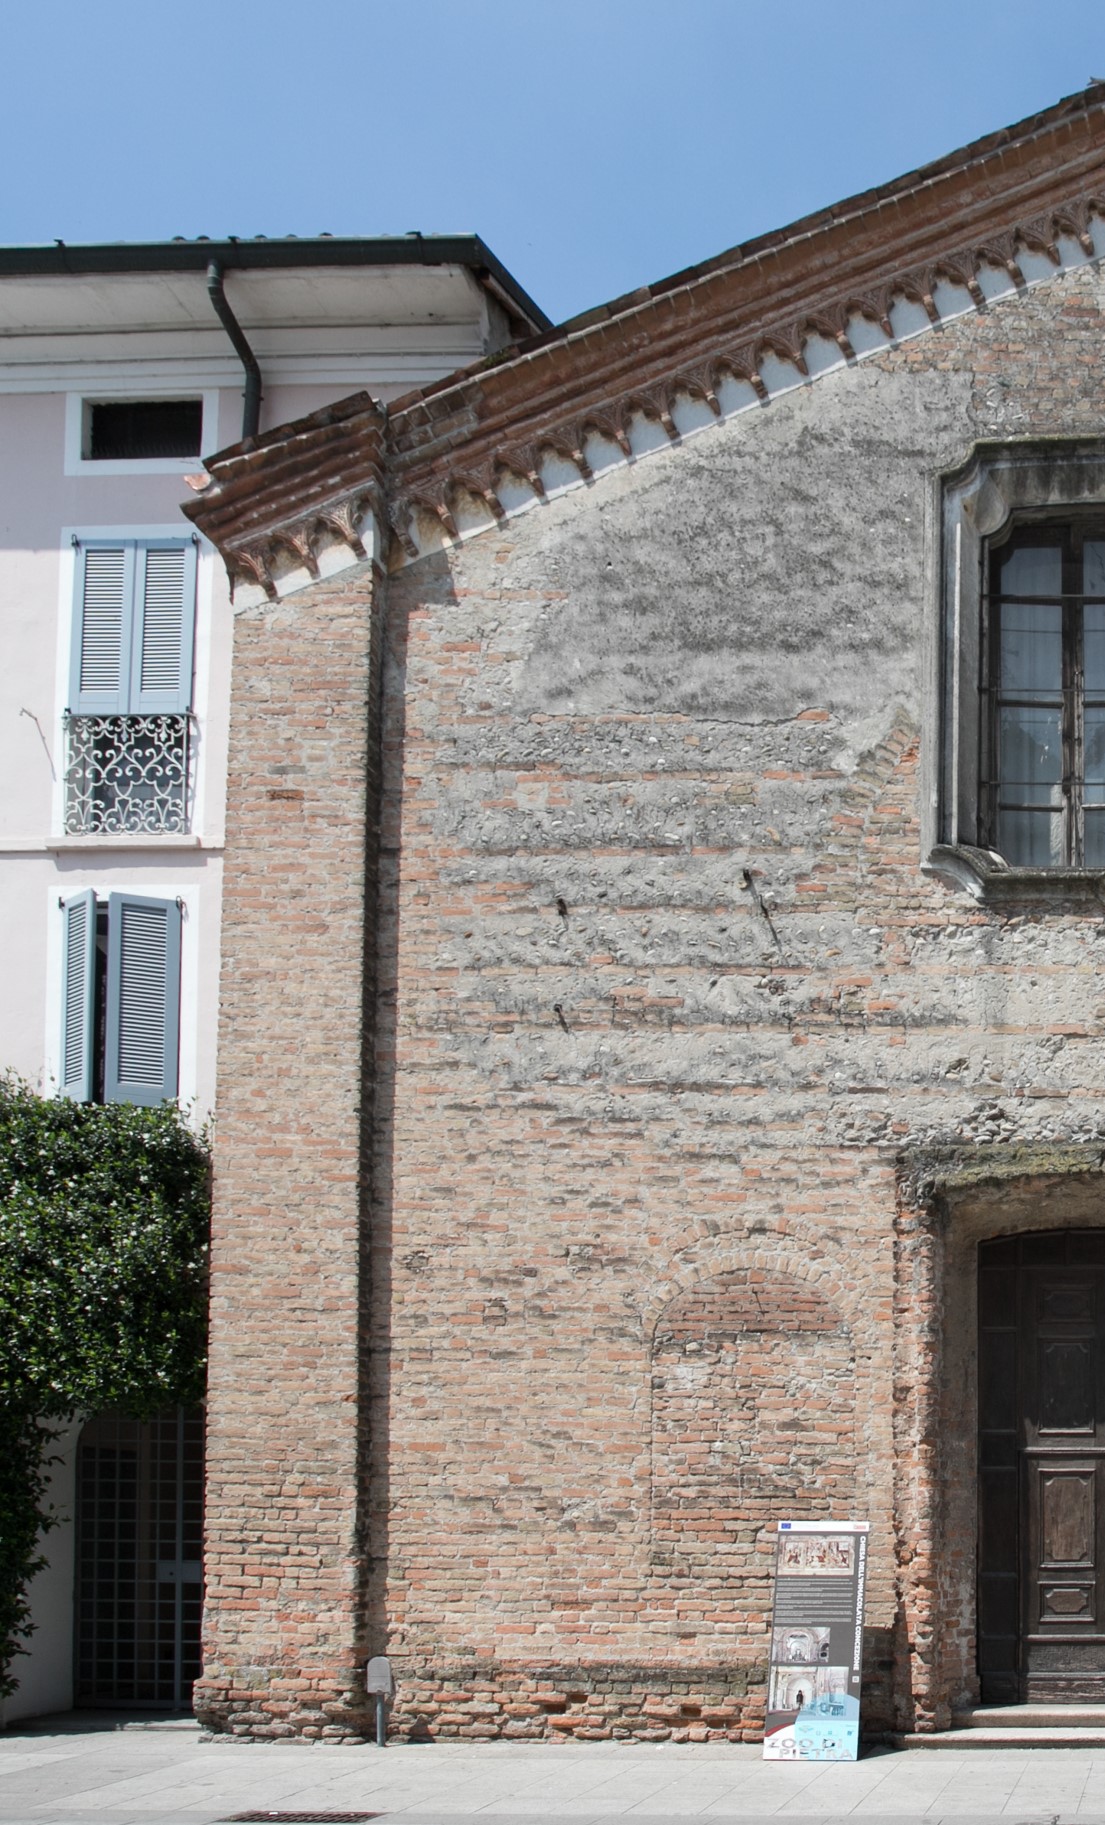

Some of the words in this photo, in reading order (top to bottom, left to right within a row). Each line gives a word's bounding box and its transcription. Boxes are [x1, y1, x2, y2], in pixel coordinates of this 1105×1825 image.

[859, 1535, 867, 1561] CHIESA
[853, 1625, 862, 1671] CONCEZIONE
[767, 1738, 814, 1749] ZOO
[822, 1738, 843, 1749] DI
[779, 1748, 853, 1759] PIETRA
